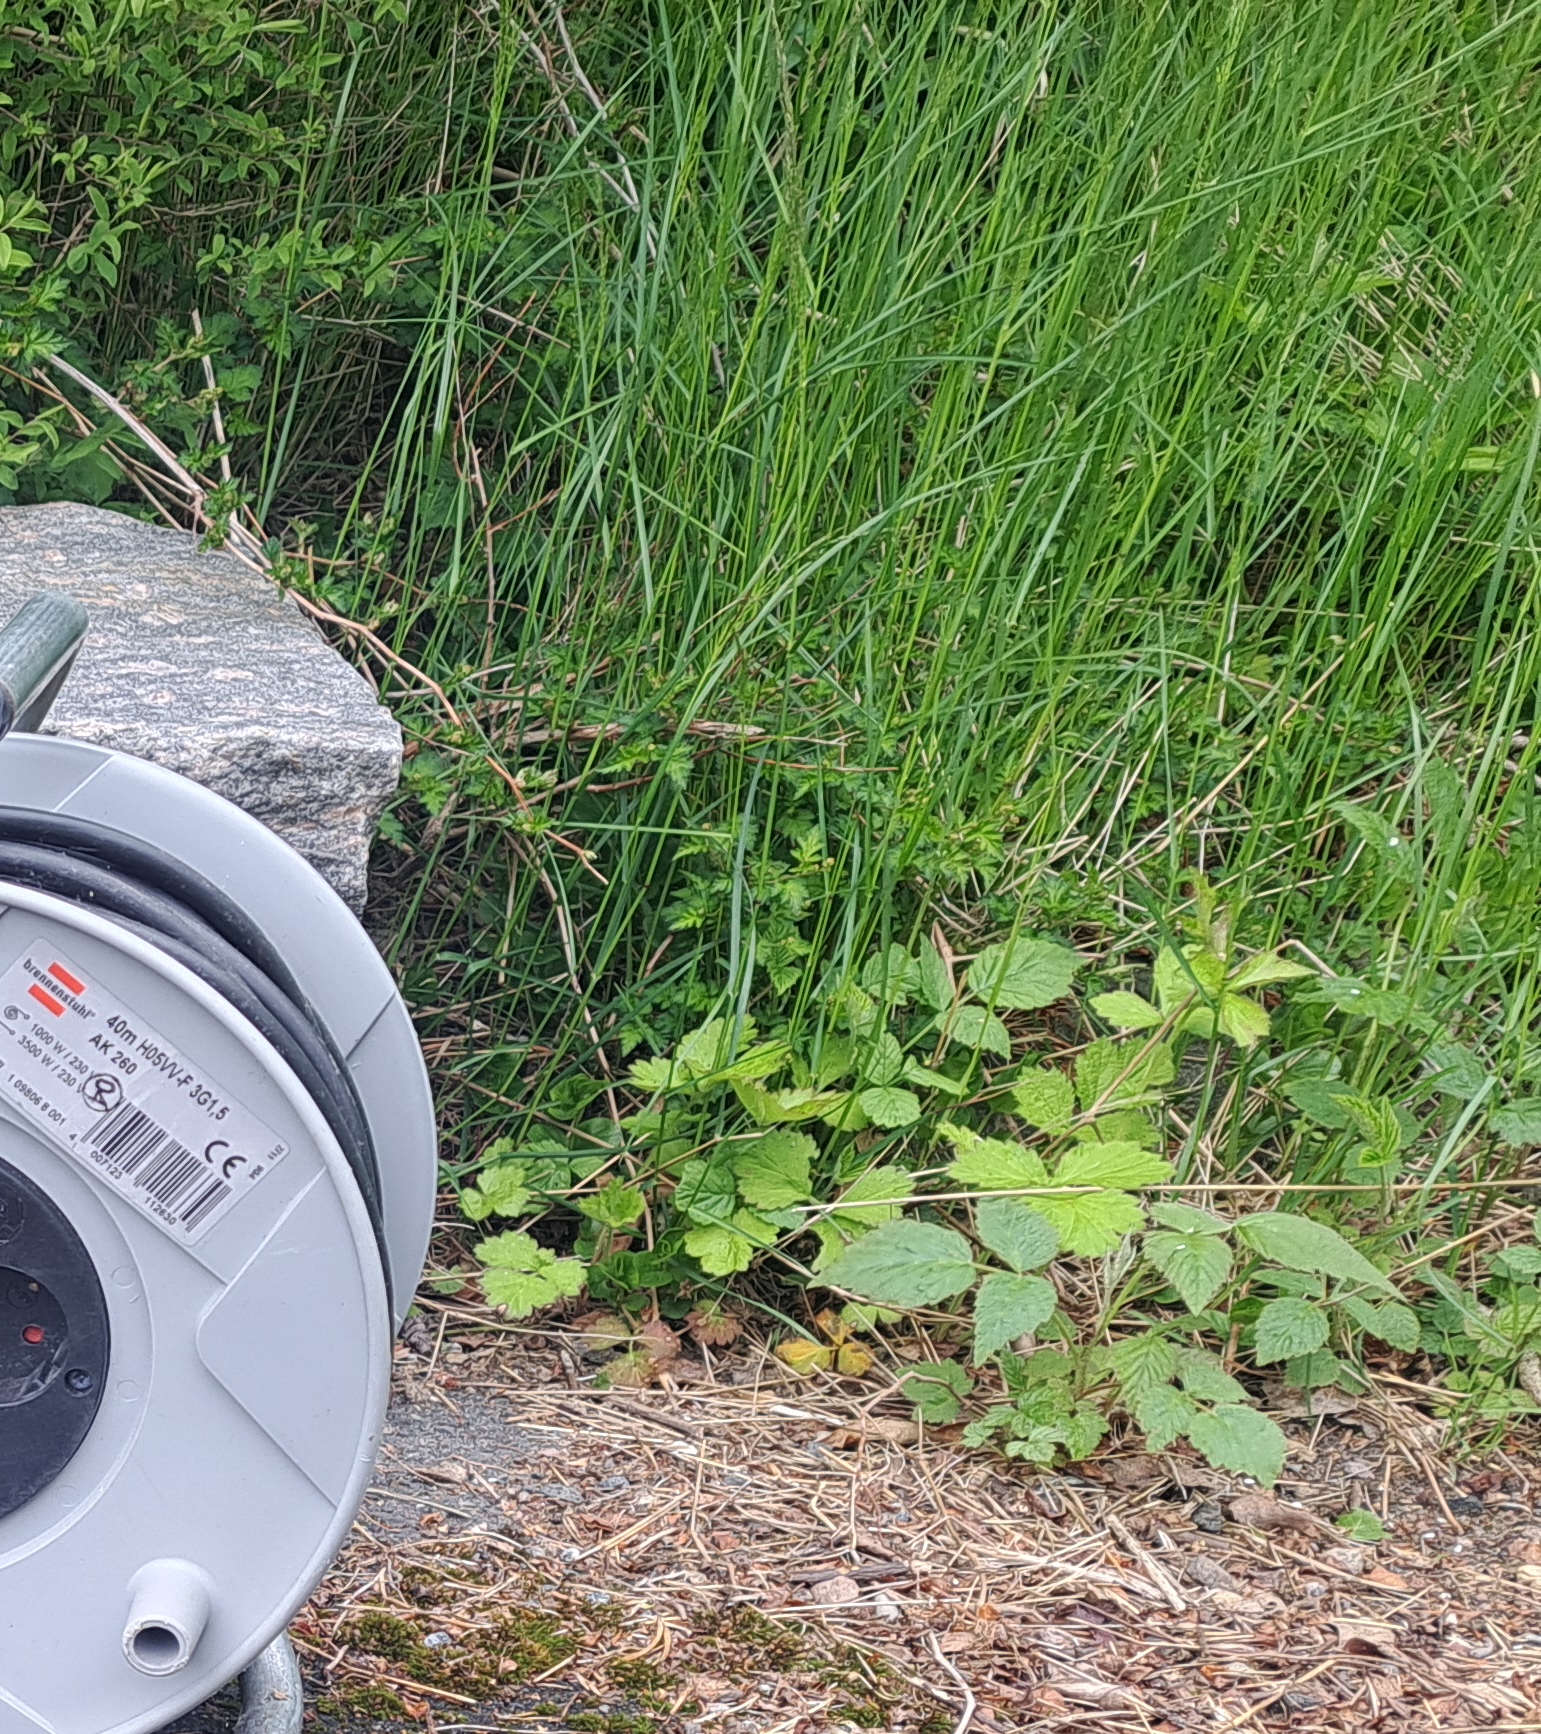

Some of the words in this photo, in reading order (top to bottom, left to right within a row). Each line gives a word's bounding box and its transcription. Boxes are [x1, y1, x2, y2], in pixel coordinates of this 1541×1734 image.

[17, 1035, 43, 1058] 3500
[41, 1053, 56, 1068] W
[57, 1068, 77, 1088] 230
[30, 1023, 55, 1046] 1000
[52, 1041, 69, 1055] W
[68, 1055, 89, 1075] 230
[88, 1033, 115, 1056] AK
[110, 1051, 138, 1076] 260
[106, 1014, 138, 1046] 40m
[135, 1038, 194, 1088] H05VV-F
[189, 1084, 230, 1121] 3G1,5
[47, 1108, 66, 1127] 001
[90, 1150, 124, 1180] 007123
